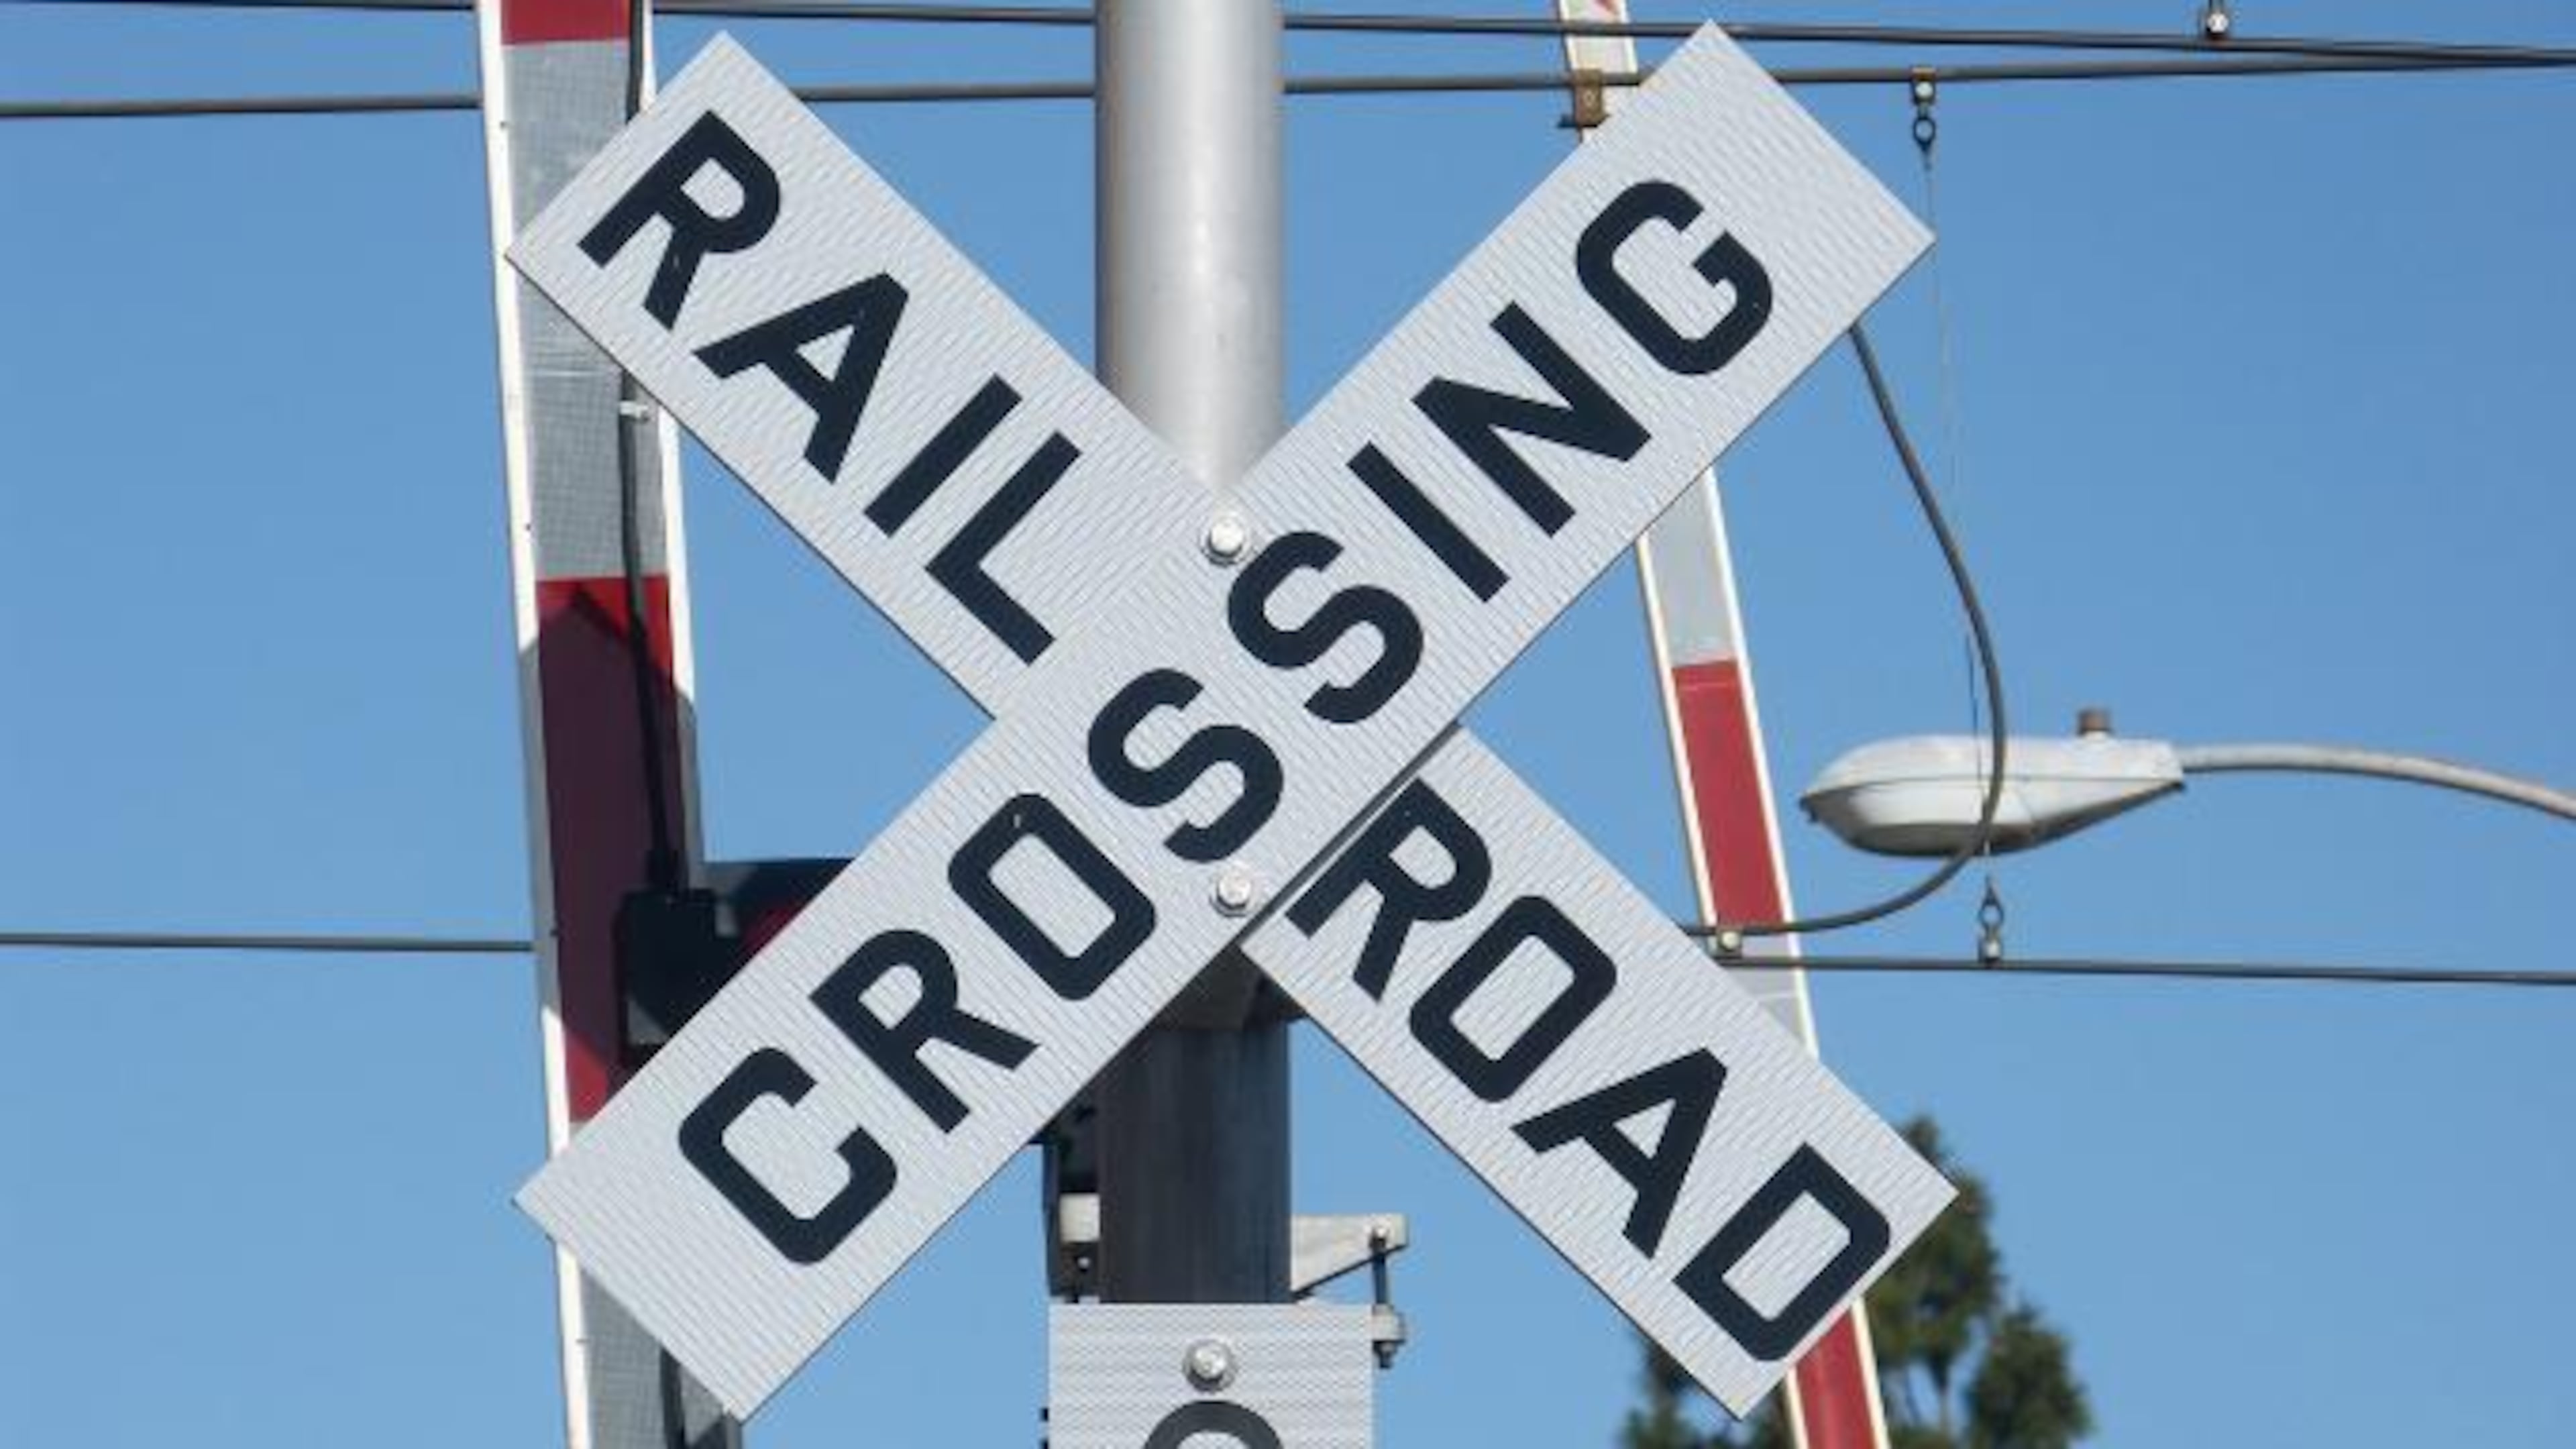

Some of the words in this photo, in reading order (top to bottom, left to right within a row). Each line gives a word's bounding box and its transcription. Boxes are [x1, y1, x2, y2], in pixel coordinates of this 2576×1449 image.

[578, 110, 1081, 664] RAIL
[1284, 777, 1891, 1362] ROAD
[678, 180, 1774, 1265] CROSSING
